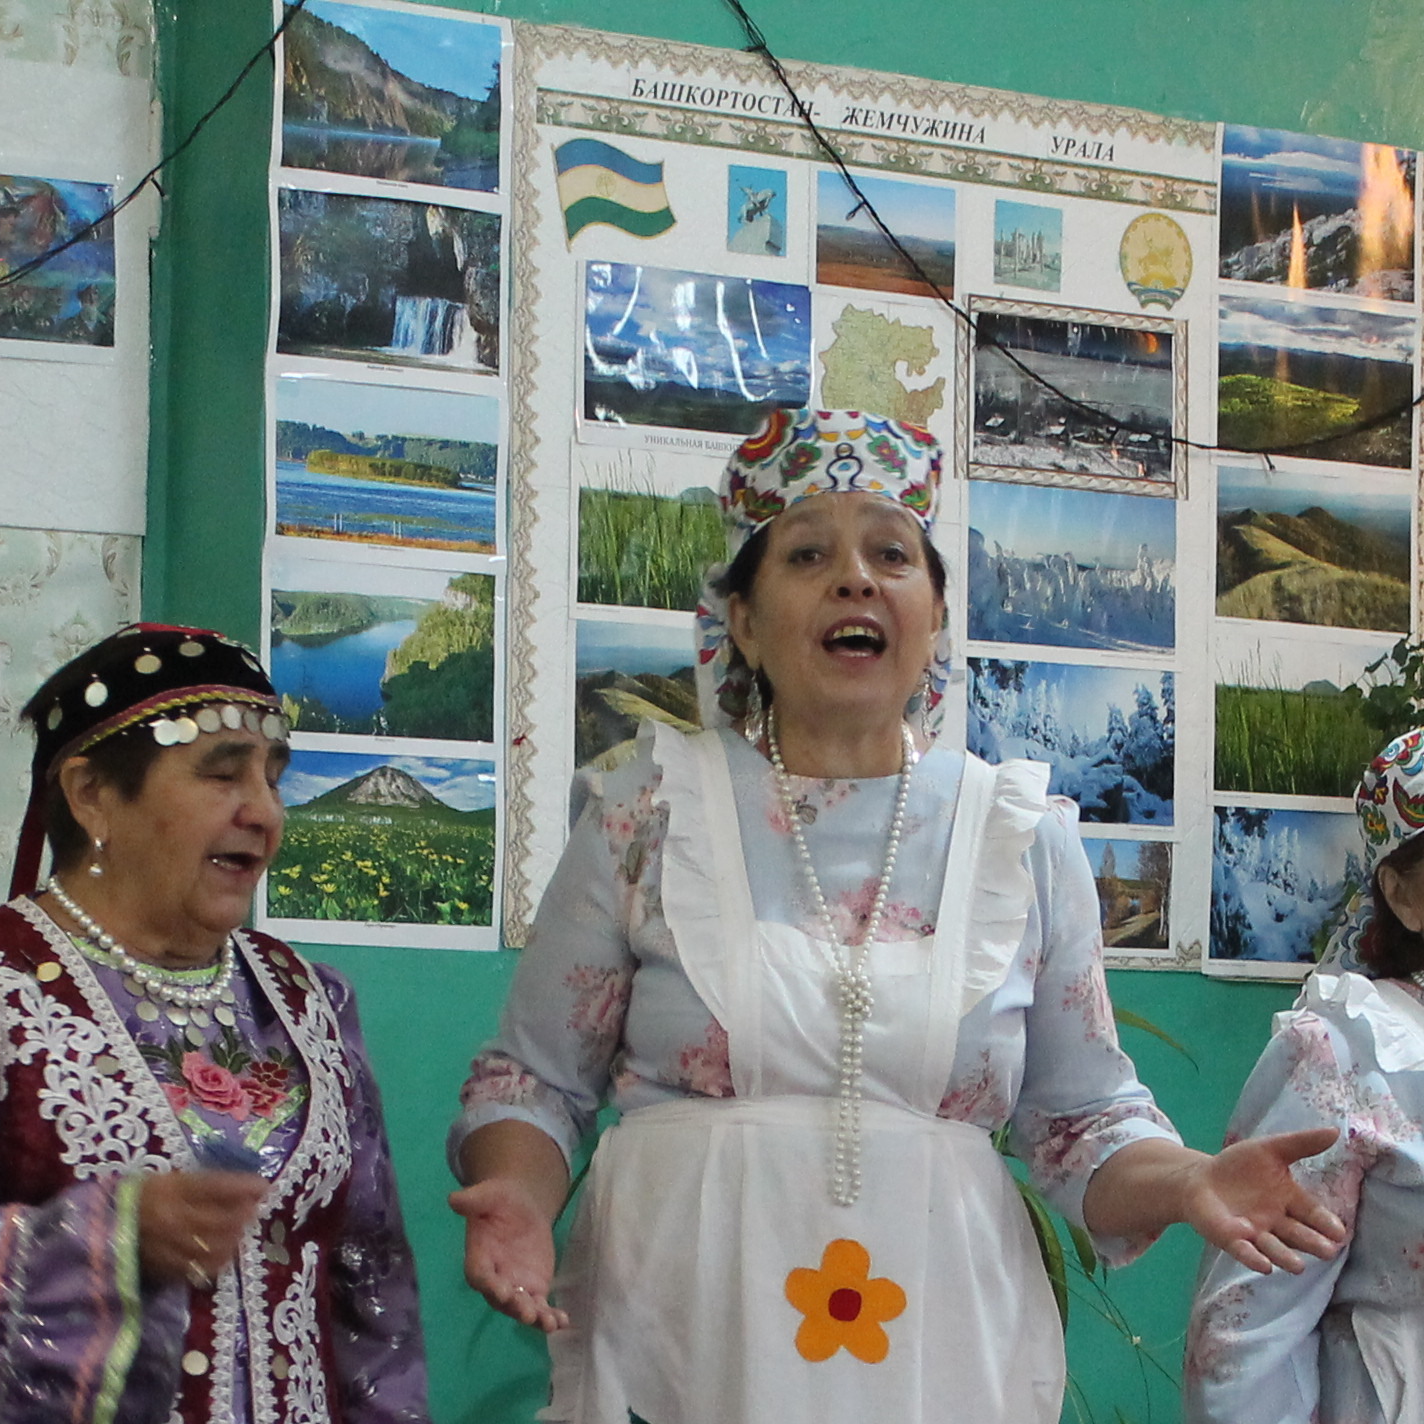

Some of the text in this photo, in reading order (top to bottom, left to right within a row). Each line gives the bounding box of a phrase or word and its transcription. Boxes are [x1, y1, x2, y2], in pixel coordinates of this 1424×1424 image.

[632, 78, 1115, 162] БАШКОРТОСТАН- ЖЕМЧУЖИНА УРАЛА
[643, 434, 703, 449] УНИКАЛЬНАЯ
